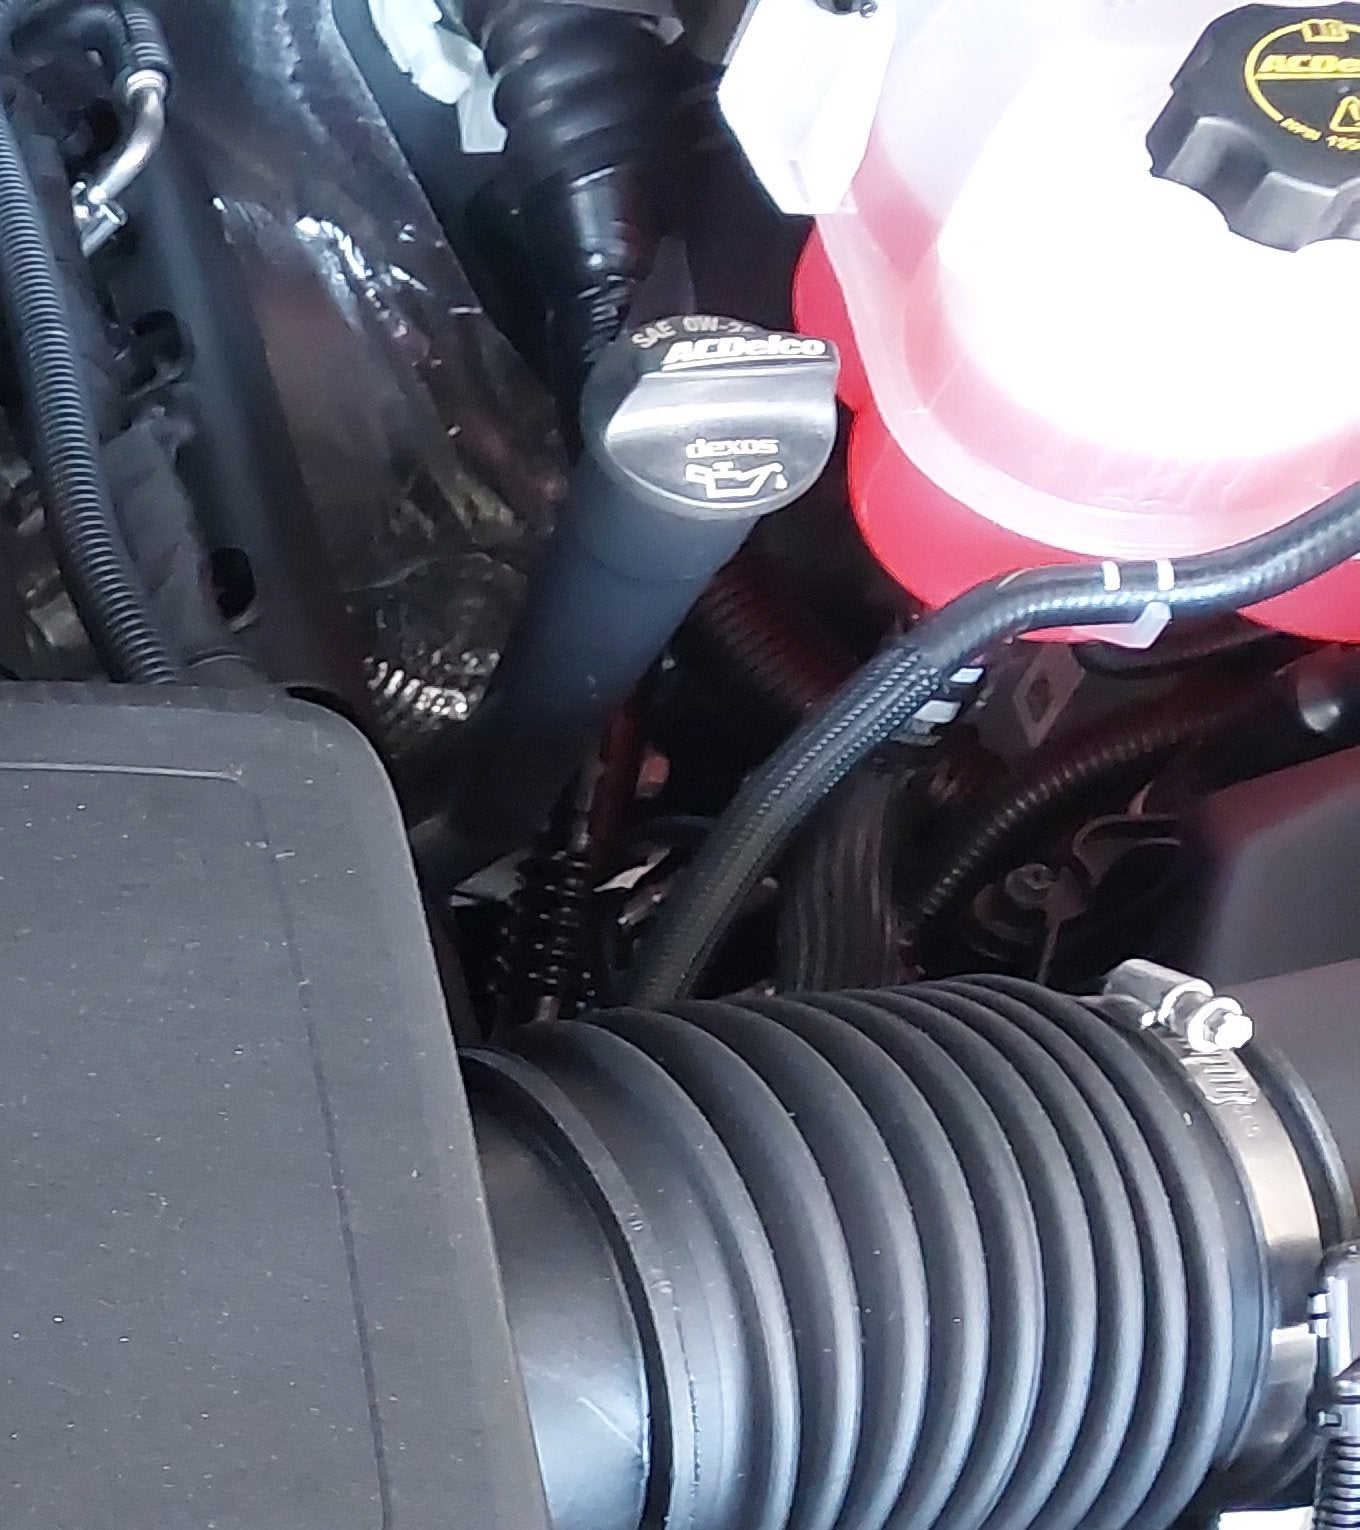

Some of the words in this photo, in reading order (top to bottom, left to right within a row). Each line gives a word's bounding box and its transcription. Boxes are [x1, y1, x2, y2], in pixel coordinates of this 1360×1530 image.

[632, 320, 677, 349] SAE
[660, 334, 826, 366] ACDelco
[685, 438, 779, 459] dexos
